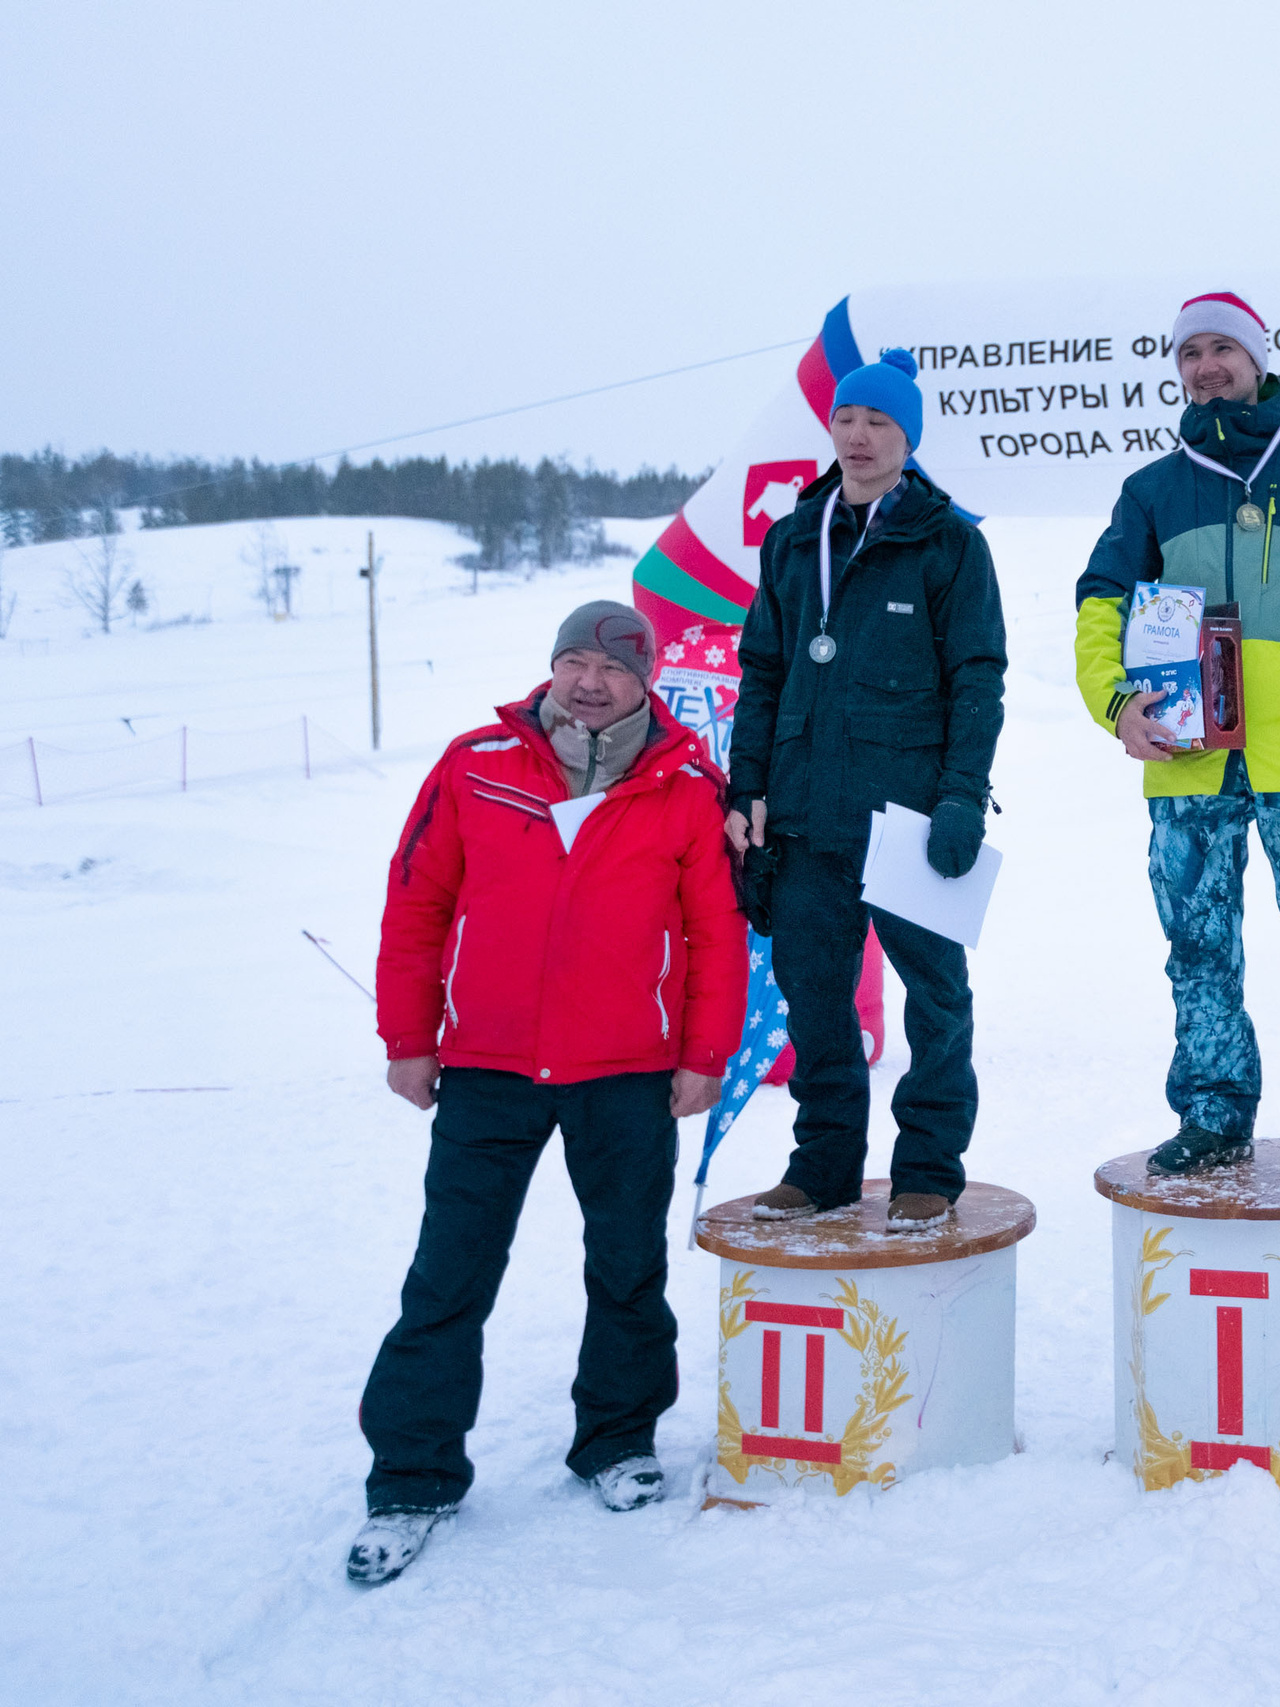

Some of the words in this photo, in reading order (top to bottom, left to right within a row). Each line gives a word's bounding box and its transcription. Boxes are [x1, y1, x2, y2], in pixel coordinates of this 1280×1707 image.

[939, 383, 1109, 416] КУЛЬТУРЫ
[1122, 381, 1144, 408] И
[980, 429, 1112, 460] ГОРОДА
[1143, 623, 1181, 639] ГРАМОТА
